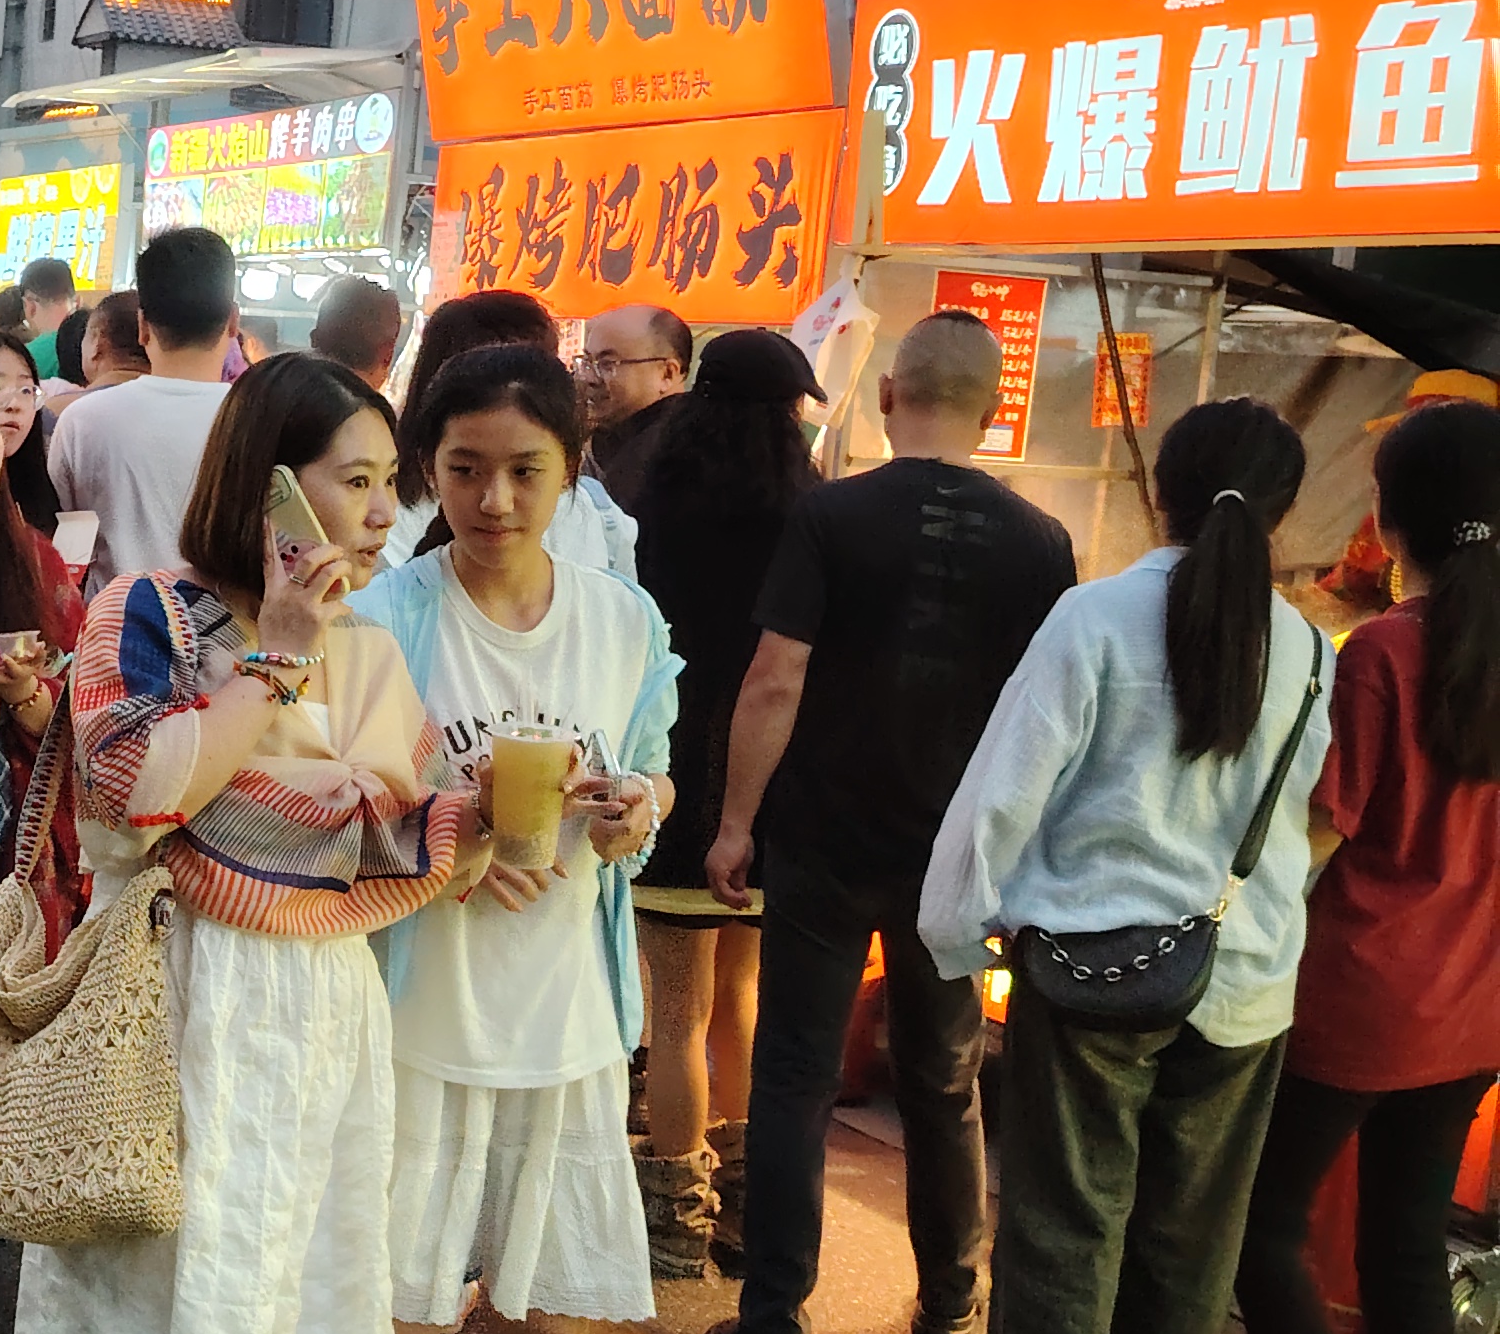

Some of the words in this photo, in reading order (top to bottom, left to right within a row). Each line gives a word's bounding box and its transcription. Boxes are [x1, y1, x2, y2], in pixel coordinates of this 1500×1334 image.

[169, 100, 358, 175] 新疆火焰山烤羊肉串
[916, 0, 1486, 206] 火爆鱿鱼
[459, 152, 803, 295] 爆烤肥肠头
